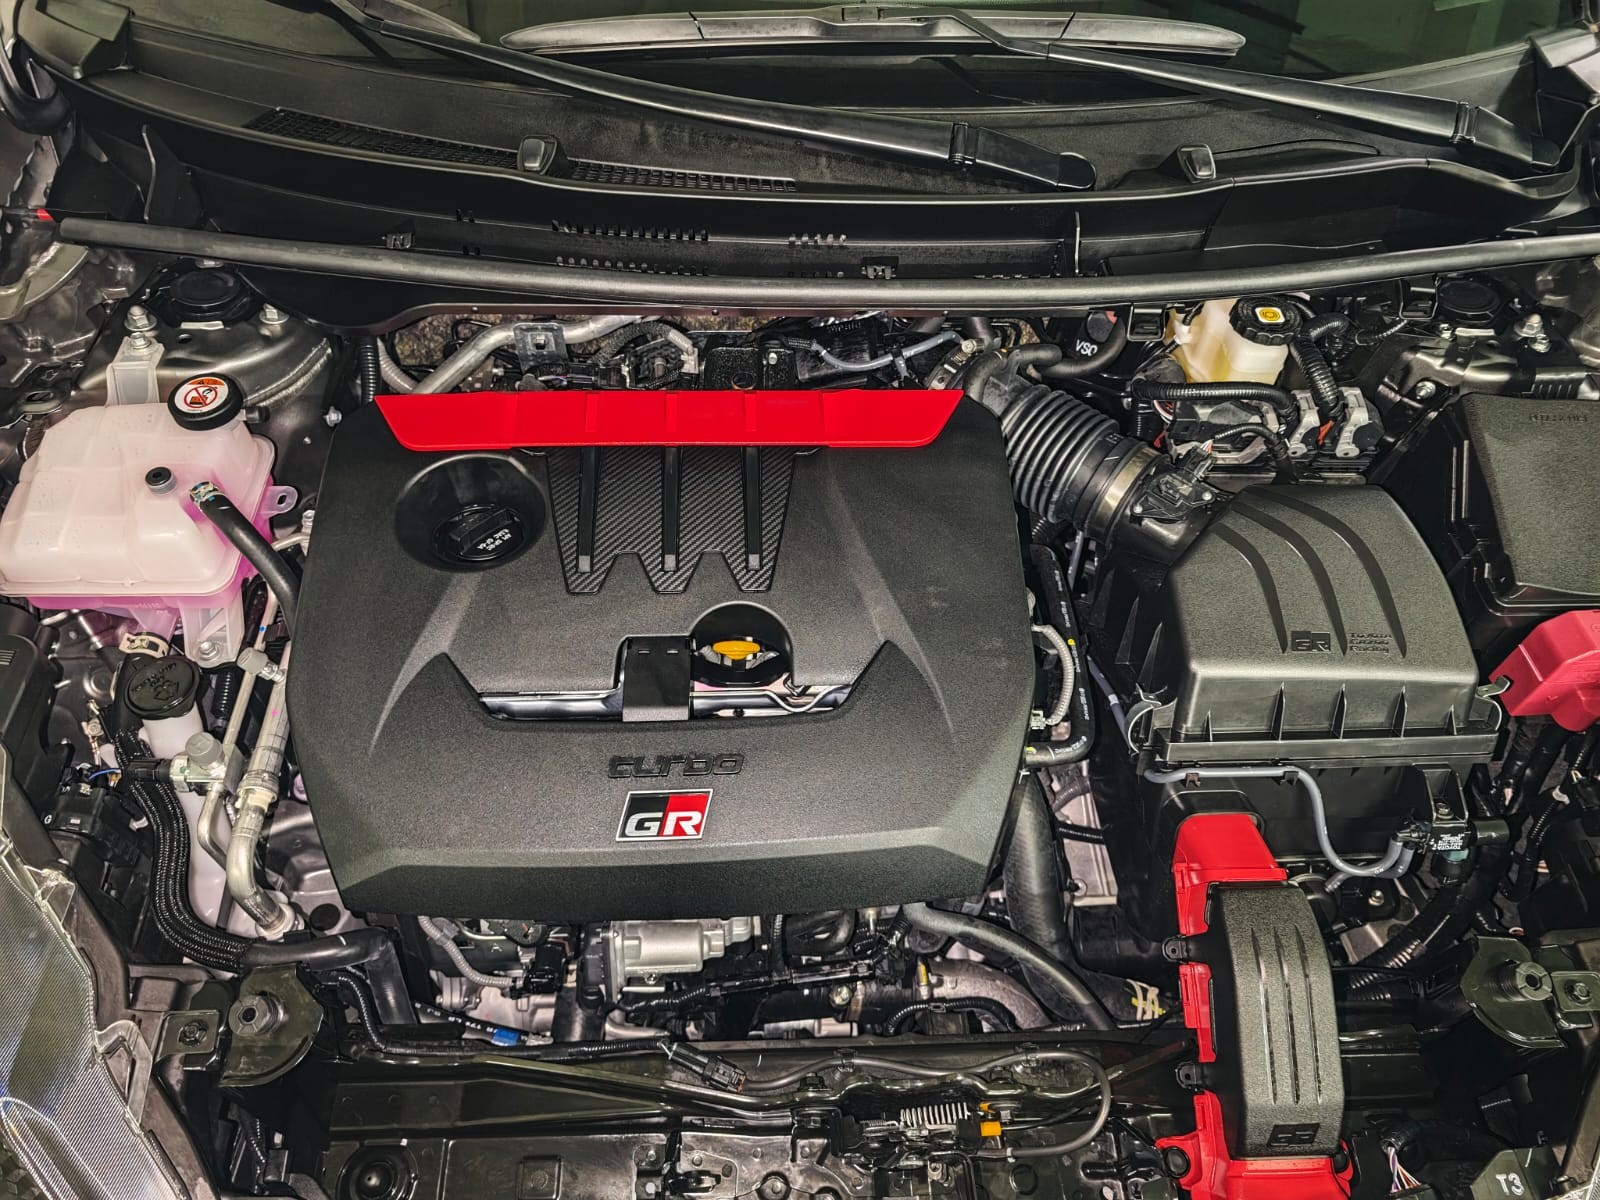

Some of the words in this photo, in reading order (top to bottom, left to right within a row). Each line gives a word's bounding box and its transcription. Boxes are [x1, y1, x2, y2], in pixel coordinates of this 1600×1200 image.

[607, 753, 744, 778] turbo
[624, 811, 702, 837] GR
[1495, 1172, 1525, 1197] T3
